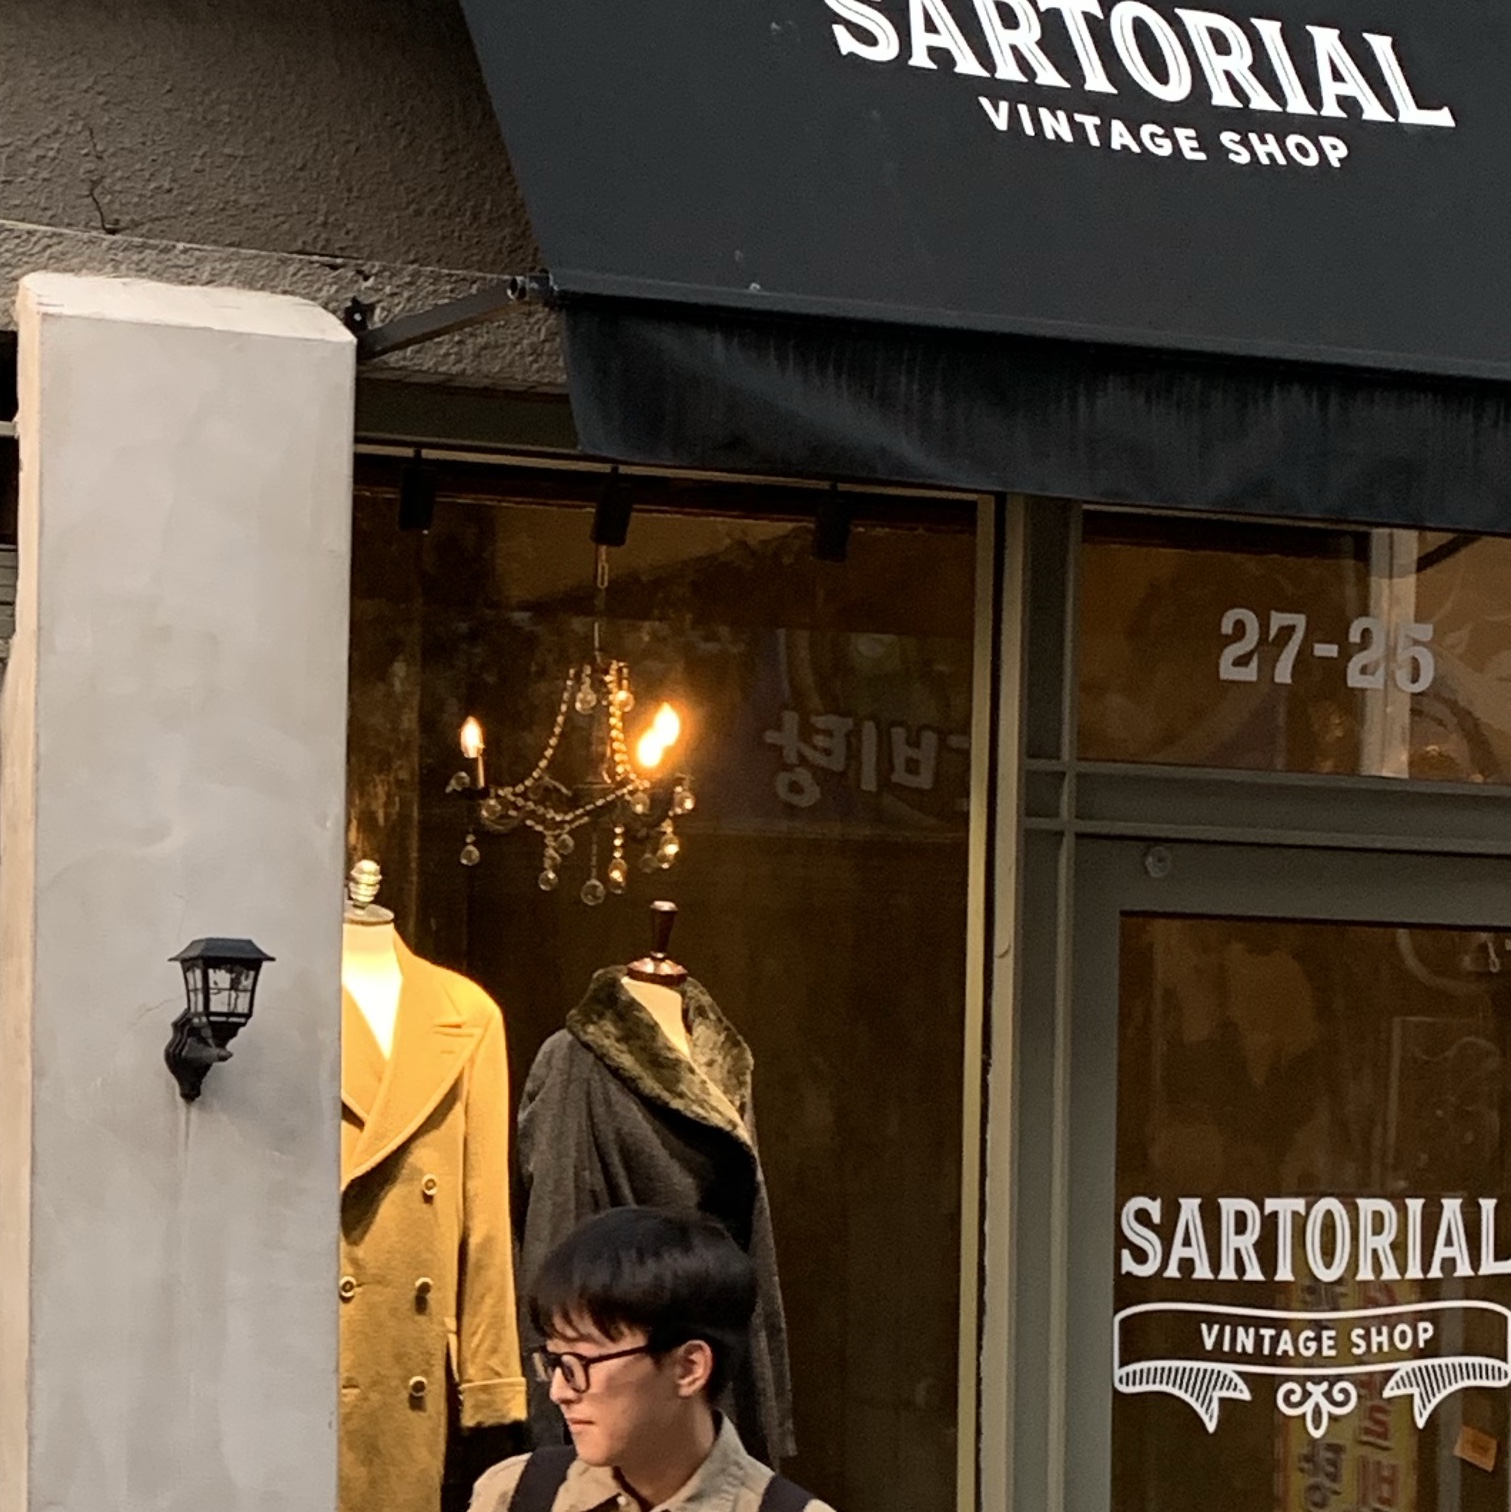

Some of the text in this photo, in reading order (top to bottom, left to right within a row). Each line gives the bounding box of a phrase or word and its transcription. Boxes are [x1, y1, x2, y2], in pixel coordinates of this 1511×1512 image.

[831, 0, 1456, 128] SARTORIAL
[978, 96, 1350, 169] VINTAGE SHOP
[1218, 607, 1435, 694] 27-25
[1120, 1195, 1511, 1283] SARTORIAL
[1200, 1321, 1435, 1357] VINTAGE SHOP
